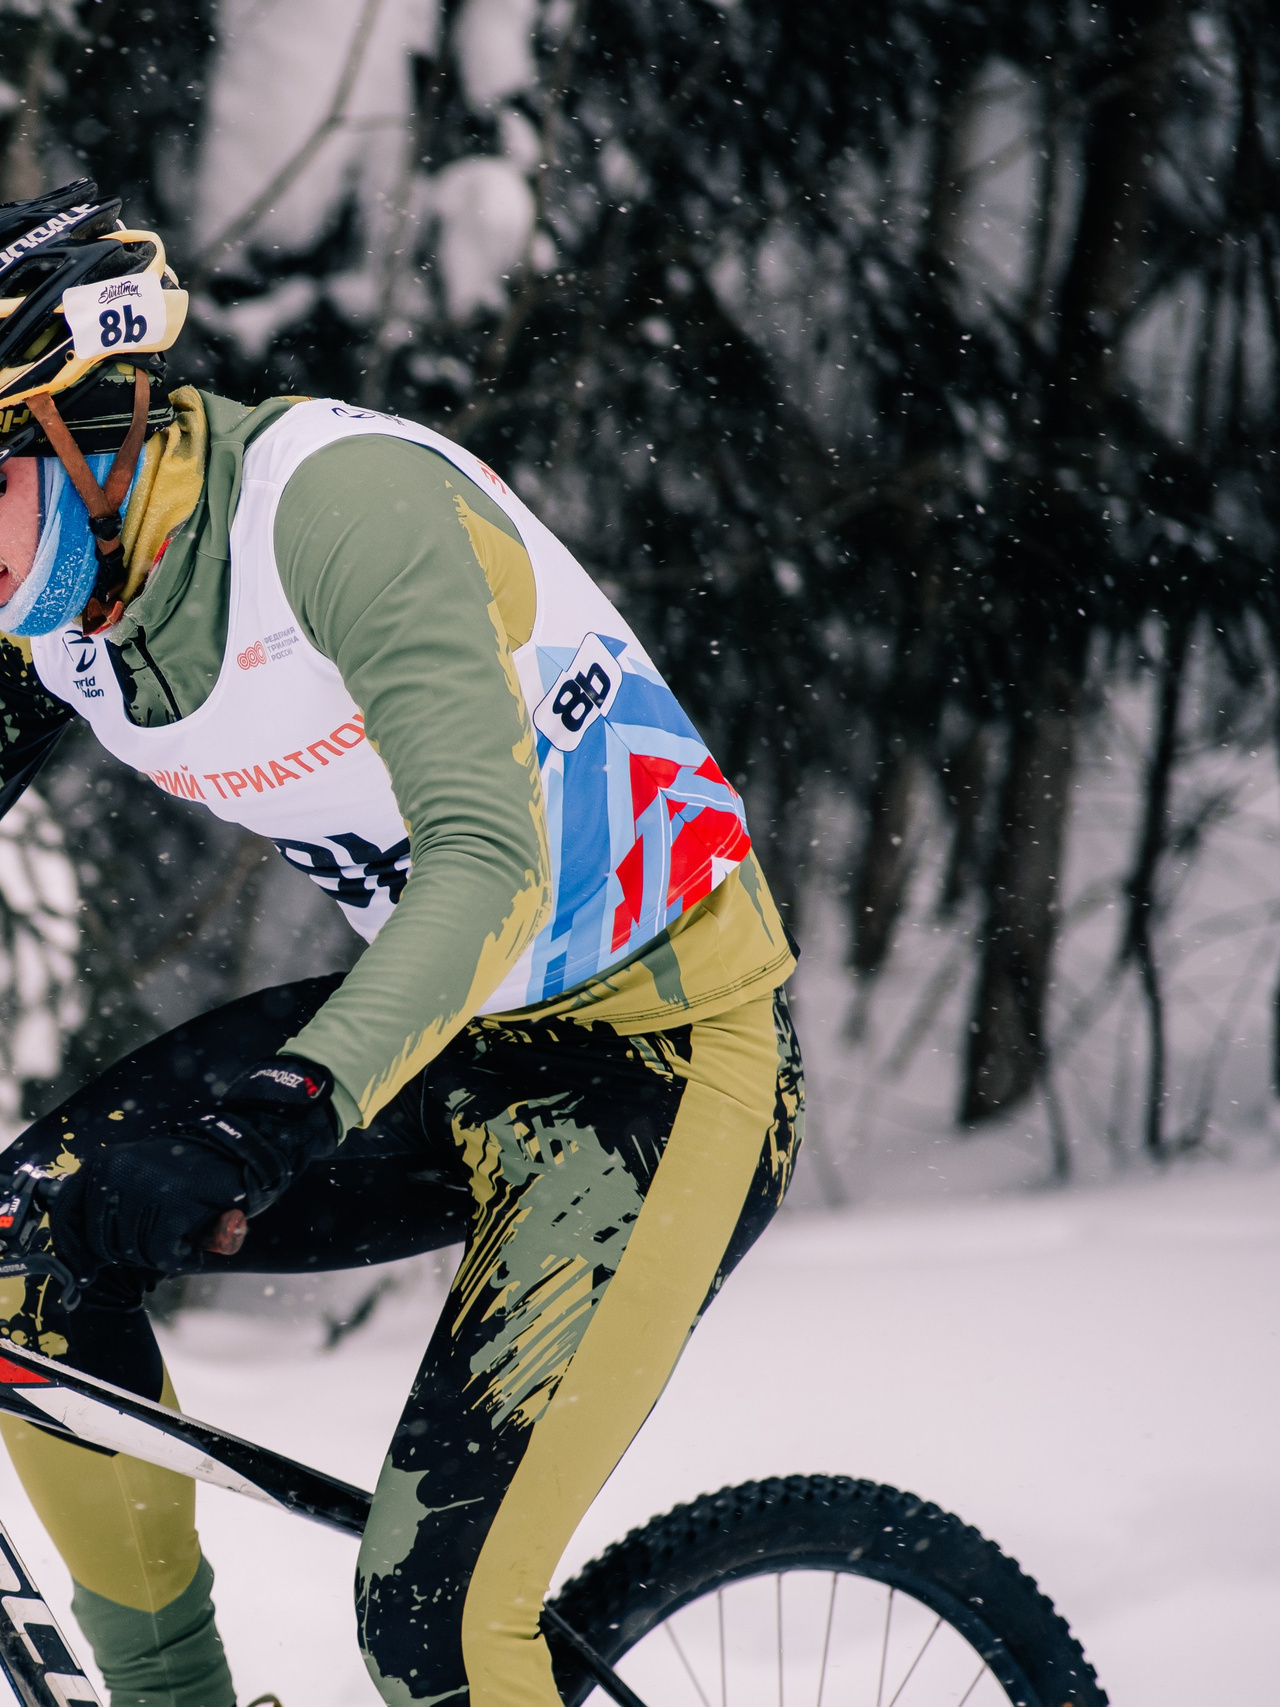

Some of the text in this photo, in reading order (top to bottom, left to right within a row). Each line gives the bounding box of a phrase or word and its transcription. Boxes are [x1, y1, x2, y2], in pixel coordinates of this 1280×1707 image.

[99, 304, 147, 347] 8b
[552, 662, 611, 732] 8b
[203, 713, 366, 800] ТРИАТЛО
